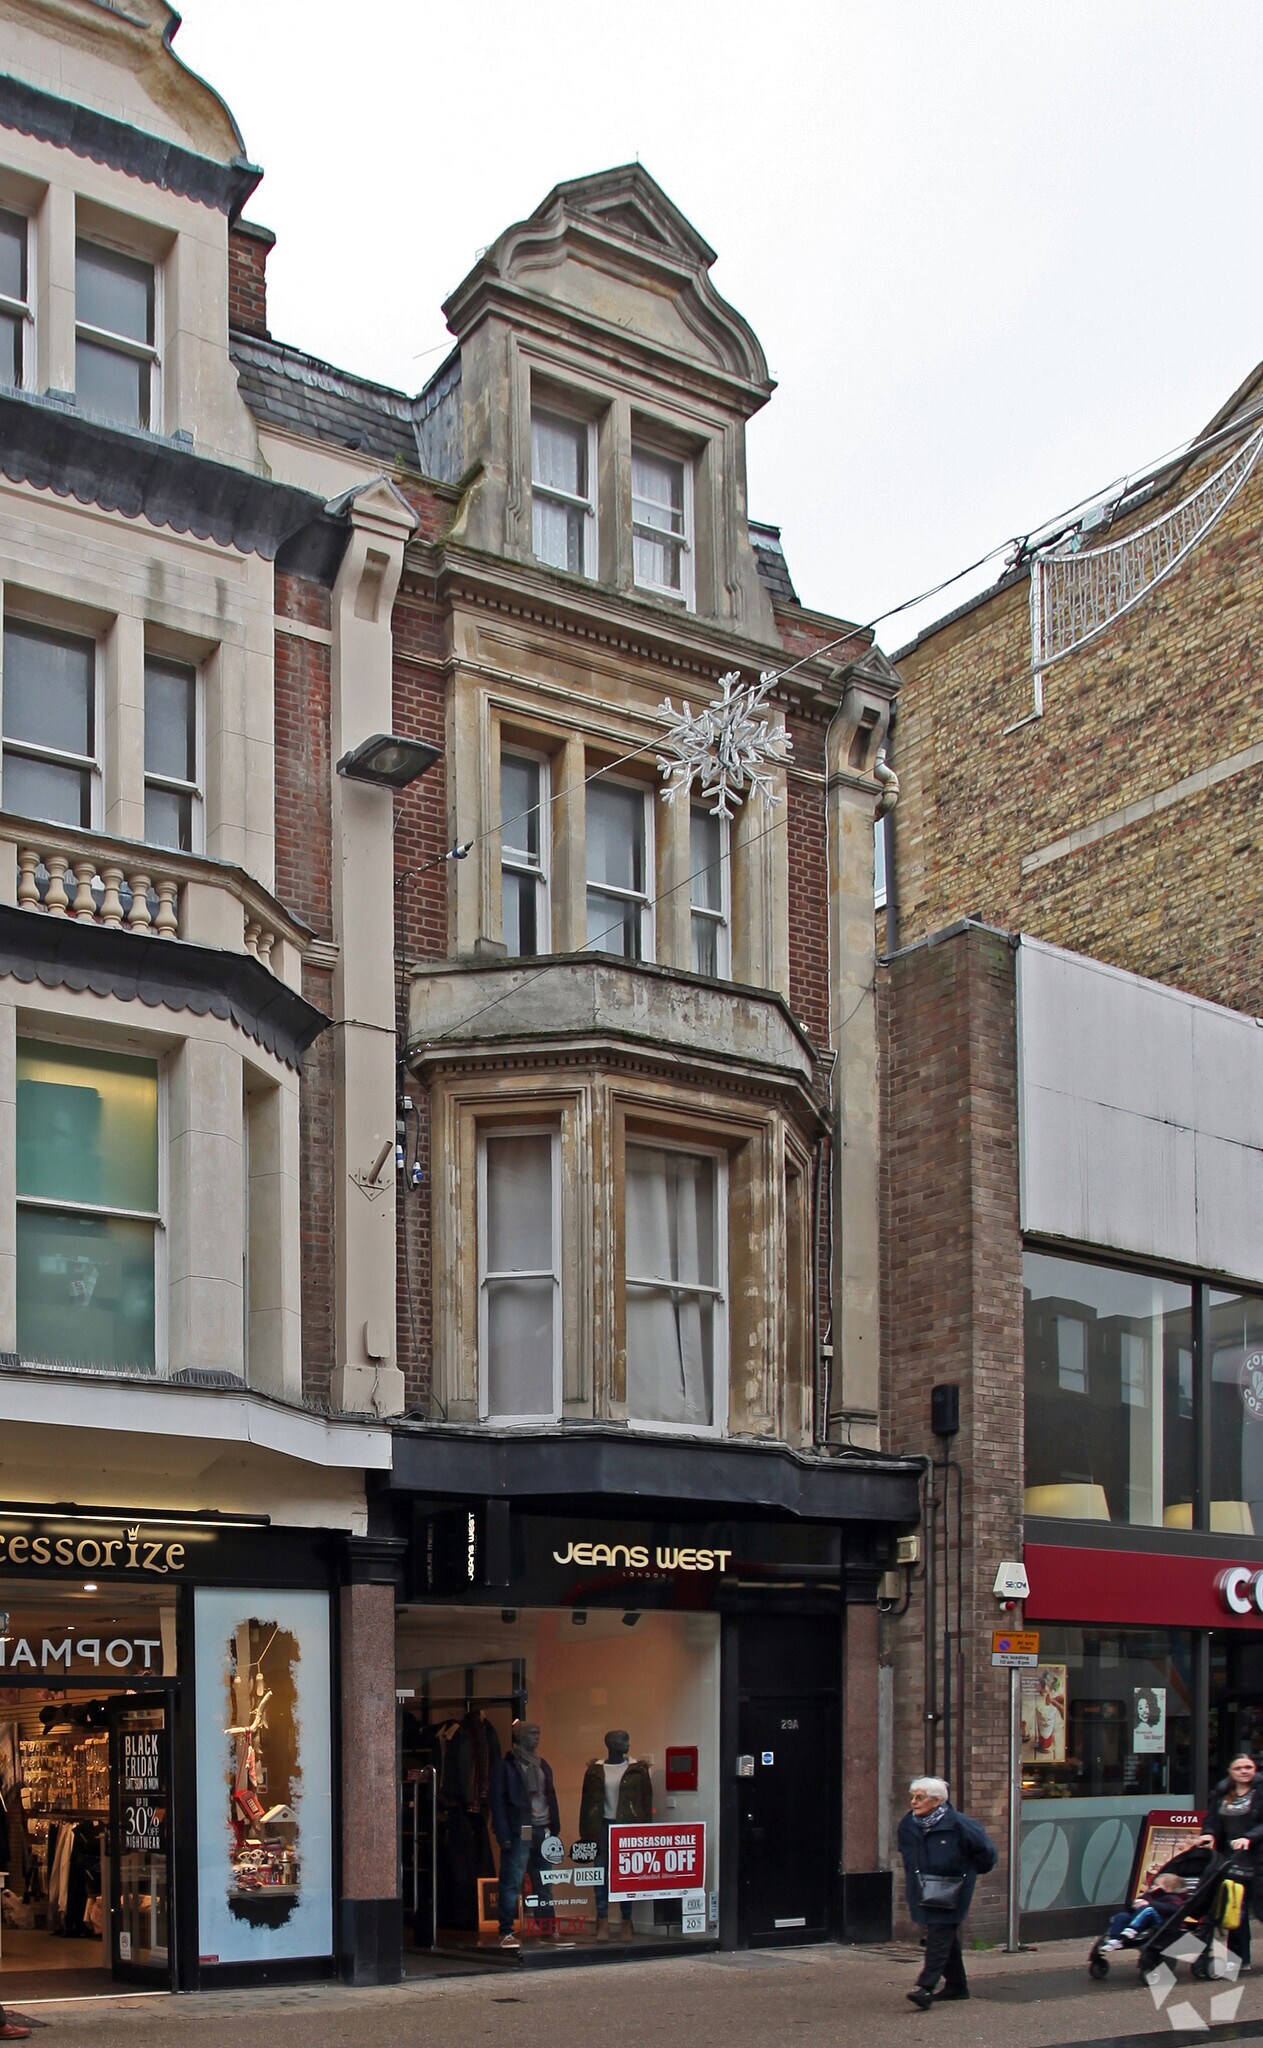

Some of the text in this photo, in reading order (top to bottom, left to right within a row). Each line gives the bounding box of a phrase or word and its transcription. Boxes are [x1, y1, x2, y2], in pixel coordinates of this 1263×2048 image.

[1247, 1354, 1263, 1371] CO
[553, 1542, 732, 1572] JEANS WEST
[781, 1719, 799, 1729] 29A
[125, 1735, 158, 1756] BLACK
[125, 1756, 159, 1777] FRIDAY
[126, 1806, 160, 1836] 30%
[1170, 1815, 1198, 1823] COSTA
[125, 1836, 161, 1849] NIGHTWEAR
[619, 1834, 696, 1848] MIDSEASON SALE
[619, 1849, 696, 1875] 50% OFF
[576, 1870, 602, 1881] DIESEL
[540, 1899, 569, 1907] G-STAR
